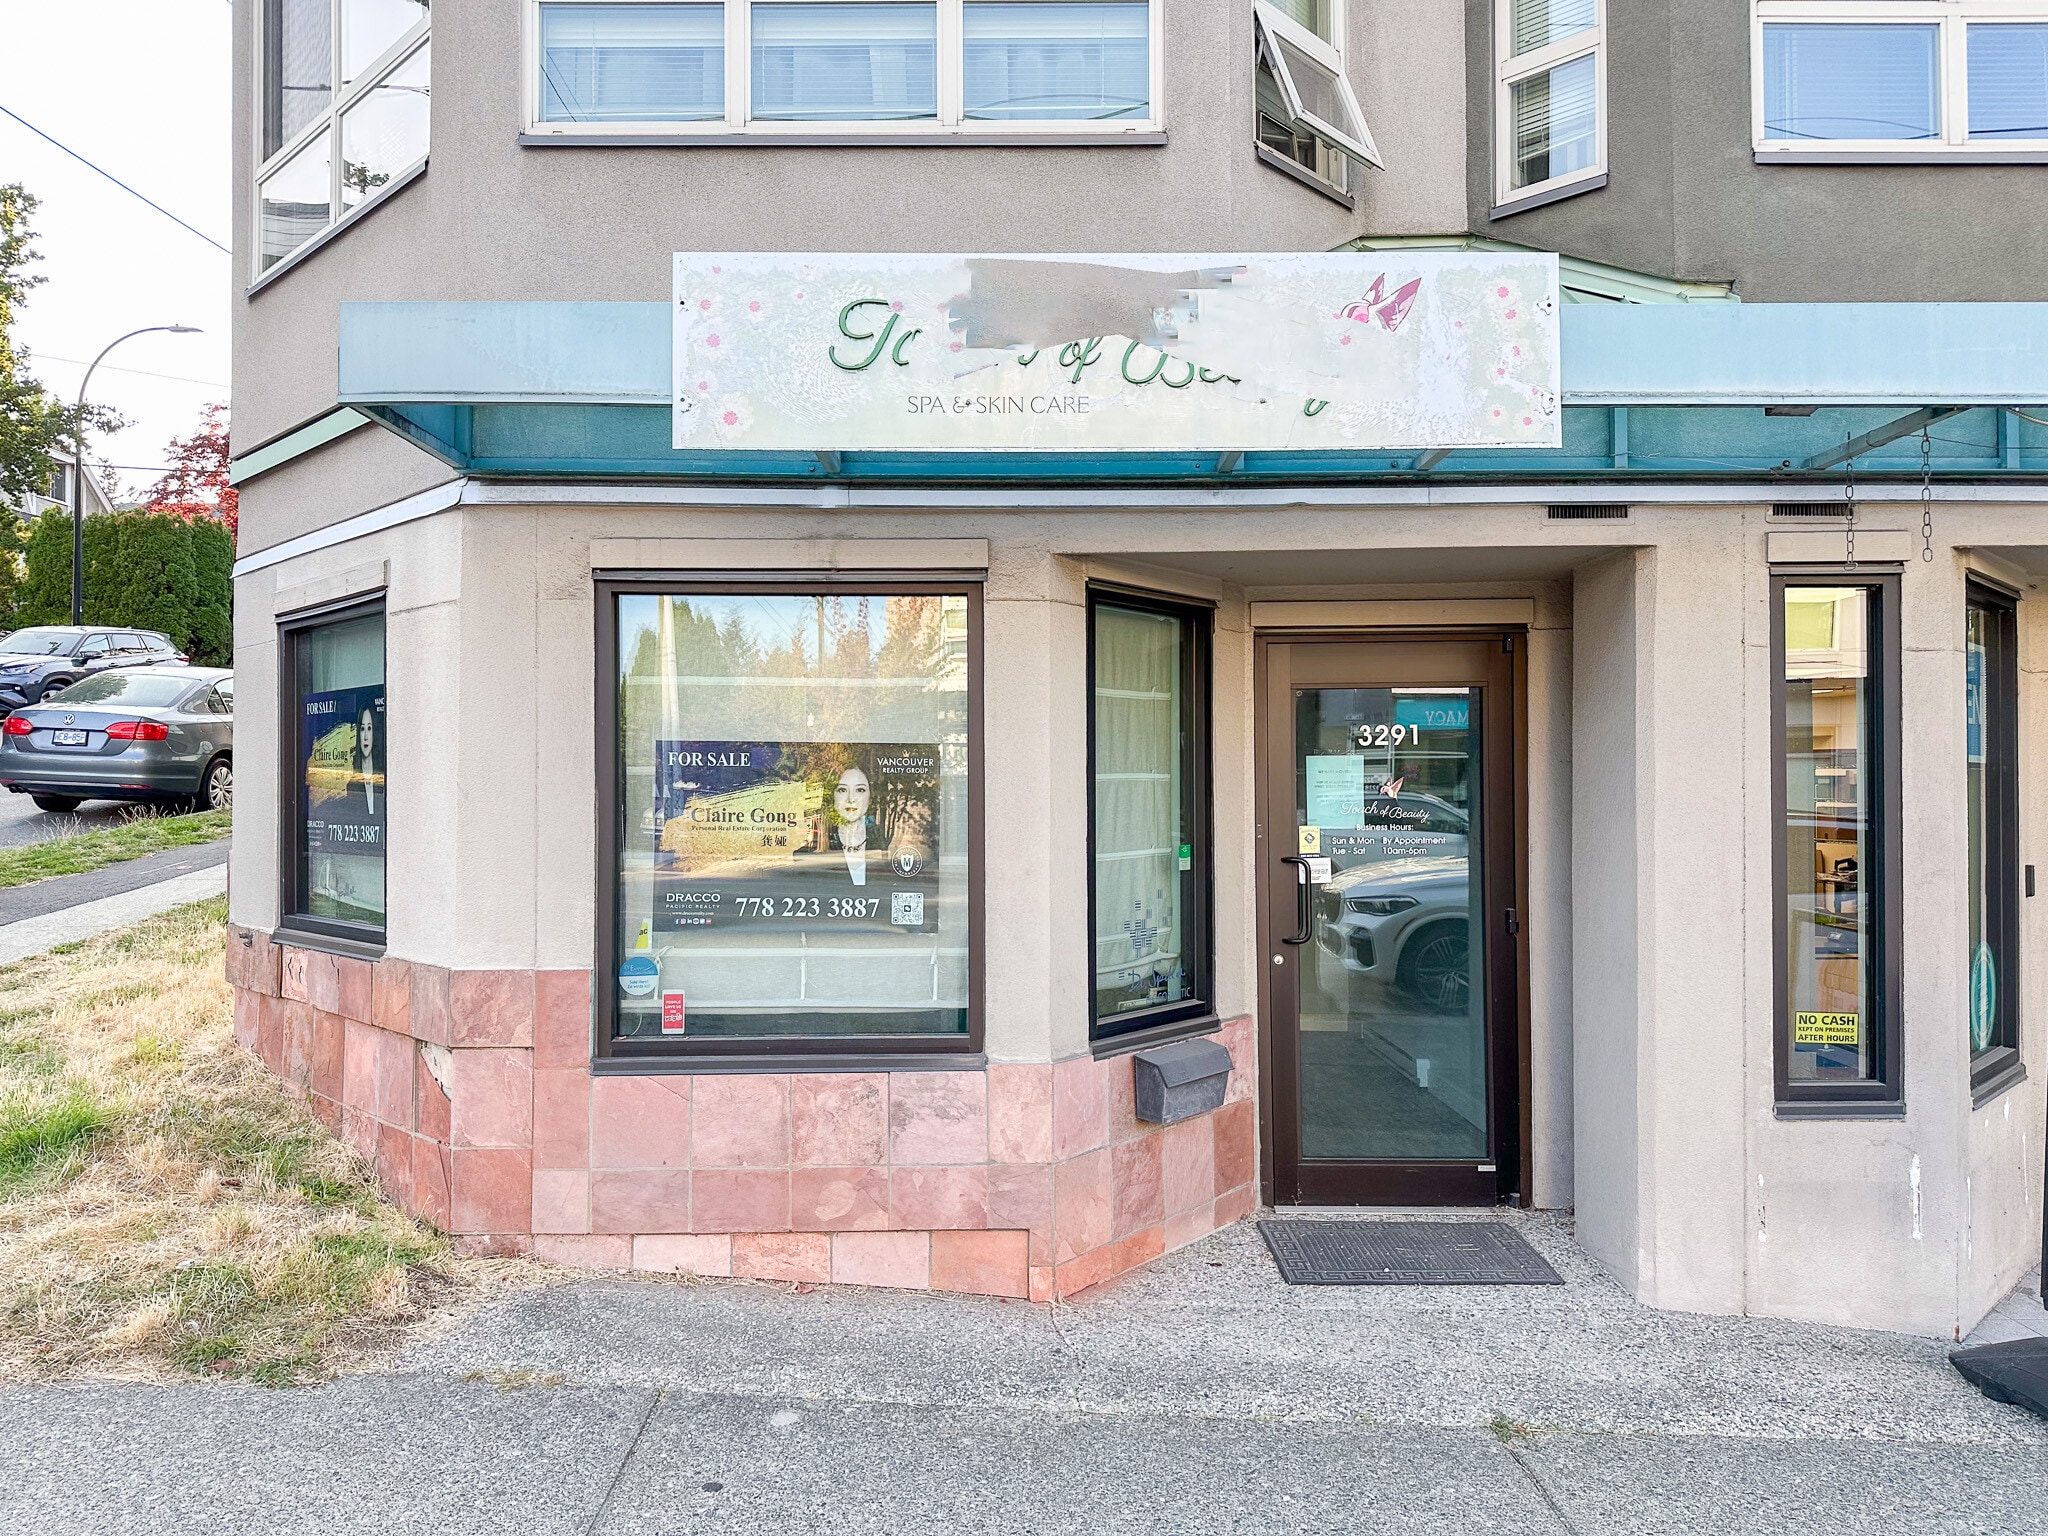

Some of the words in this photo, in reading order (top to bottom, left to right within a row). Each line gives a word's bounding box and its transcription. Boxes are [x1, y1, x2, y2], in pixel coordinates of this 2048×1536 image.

[907, 396, 946, 414] SPA
[952, 396, 967, 414] &
[975, 396, 1024, 414] SKIN
[1030, 396, 1090, 414] CARE
[306, 702, 319, 716] FOR
[1357, 724, 1419, 747] 3291
[314, 748, 332, 762] Claire
[332, 747, 349, 764] Gong
[668, 751, 704, 767] FOR
[707, 752, 751, 767] SALE
[877, 757, 934, 767] VANCOUVER
[691, 808, 745, 823] Claire
[750, 808, 797, 828] Gong
[1340, 800, 1379, 815] Touch
[1379, 804, 1391, 818] of
[1388, 806, 1431, 824] Beauty
[328, 824, 343, 842] 778
[344, 825, 359, 843] 223
[360, 825, 380, 844] 3887
[751, 825, 787, 833] Corporation
[1331, 836, 1347, 845] Sun
[1348, 836, 1355, 844] &
[1356, 836, 1375, 845] Mon
[1382, 836, 1392, 846] By
[1393, 836, 1446, 846] Appointment
[1331, 847, 1346, 855] Tue
[1353, 847, 1366, 855] Sat
[1382, 847, 1427, 856] 10am-6pm
[666, 893, 721, 903] DRACCO
[735, 897, 775, 917] 778
[781, 897, 820, 917] 223
[827, 898, 880, 918] 3887
[1798, 1015, 1818, 1025] NO
[1821, 1016, 1855, 1026] CASH
[1826, 1034, 1855, 1042] HOURS
